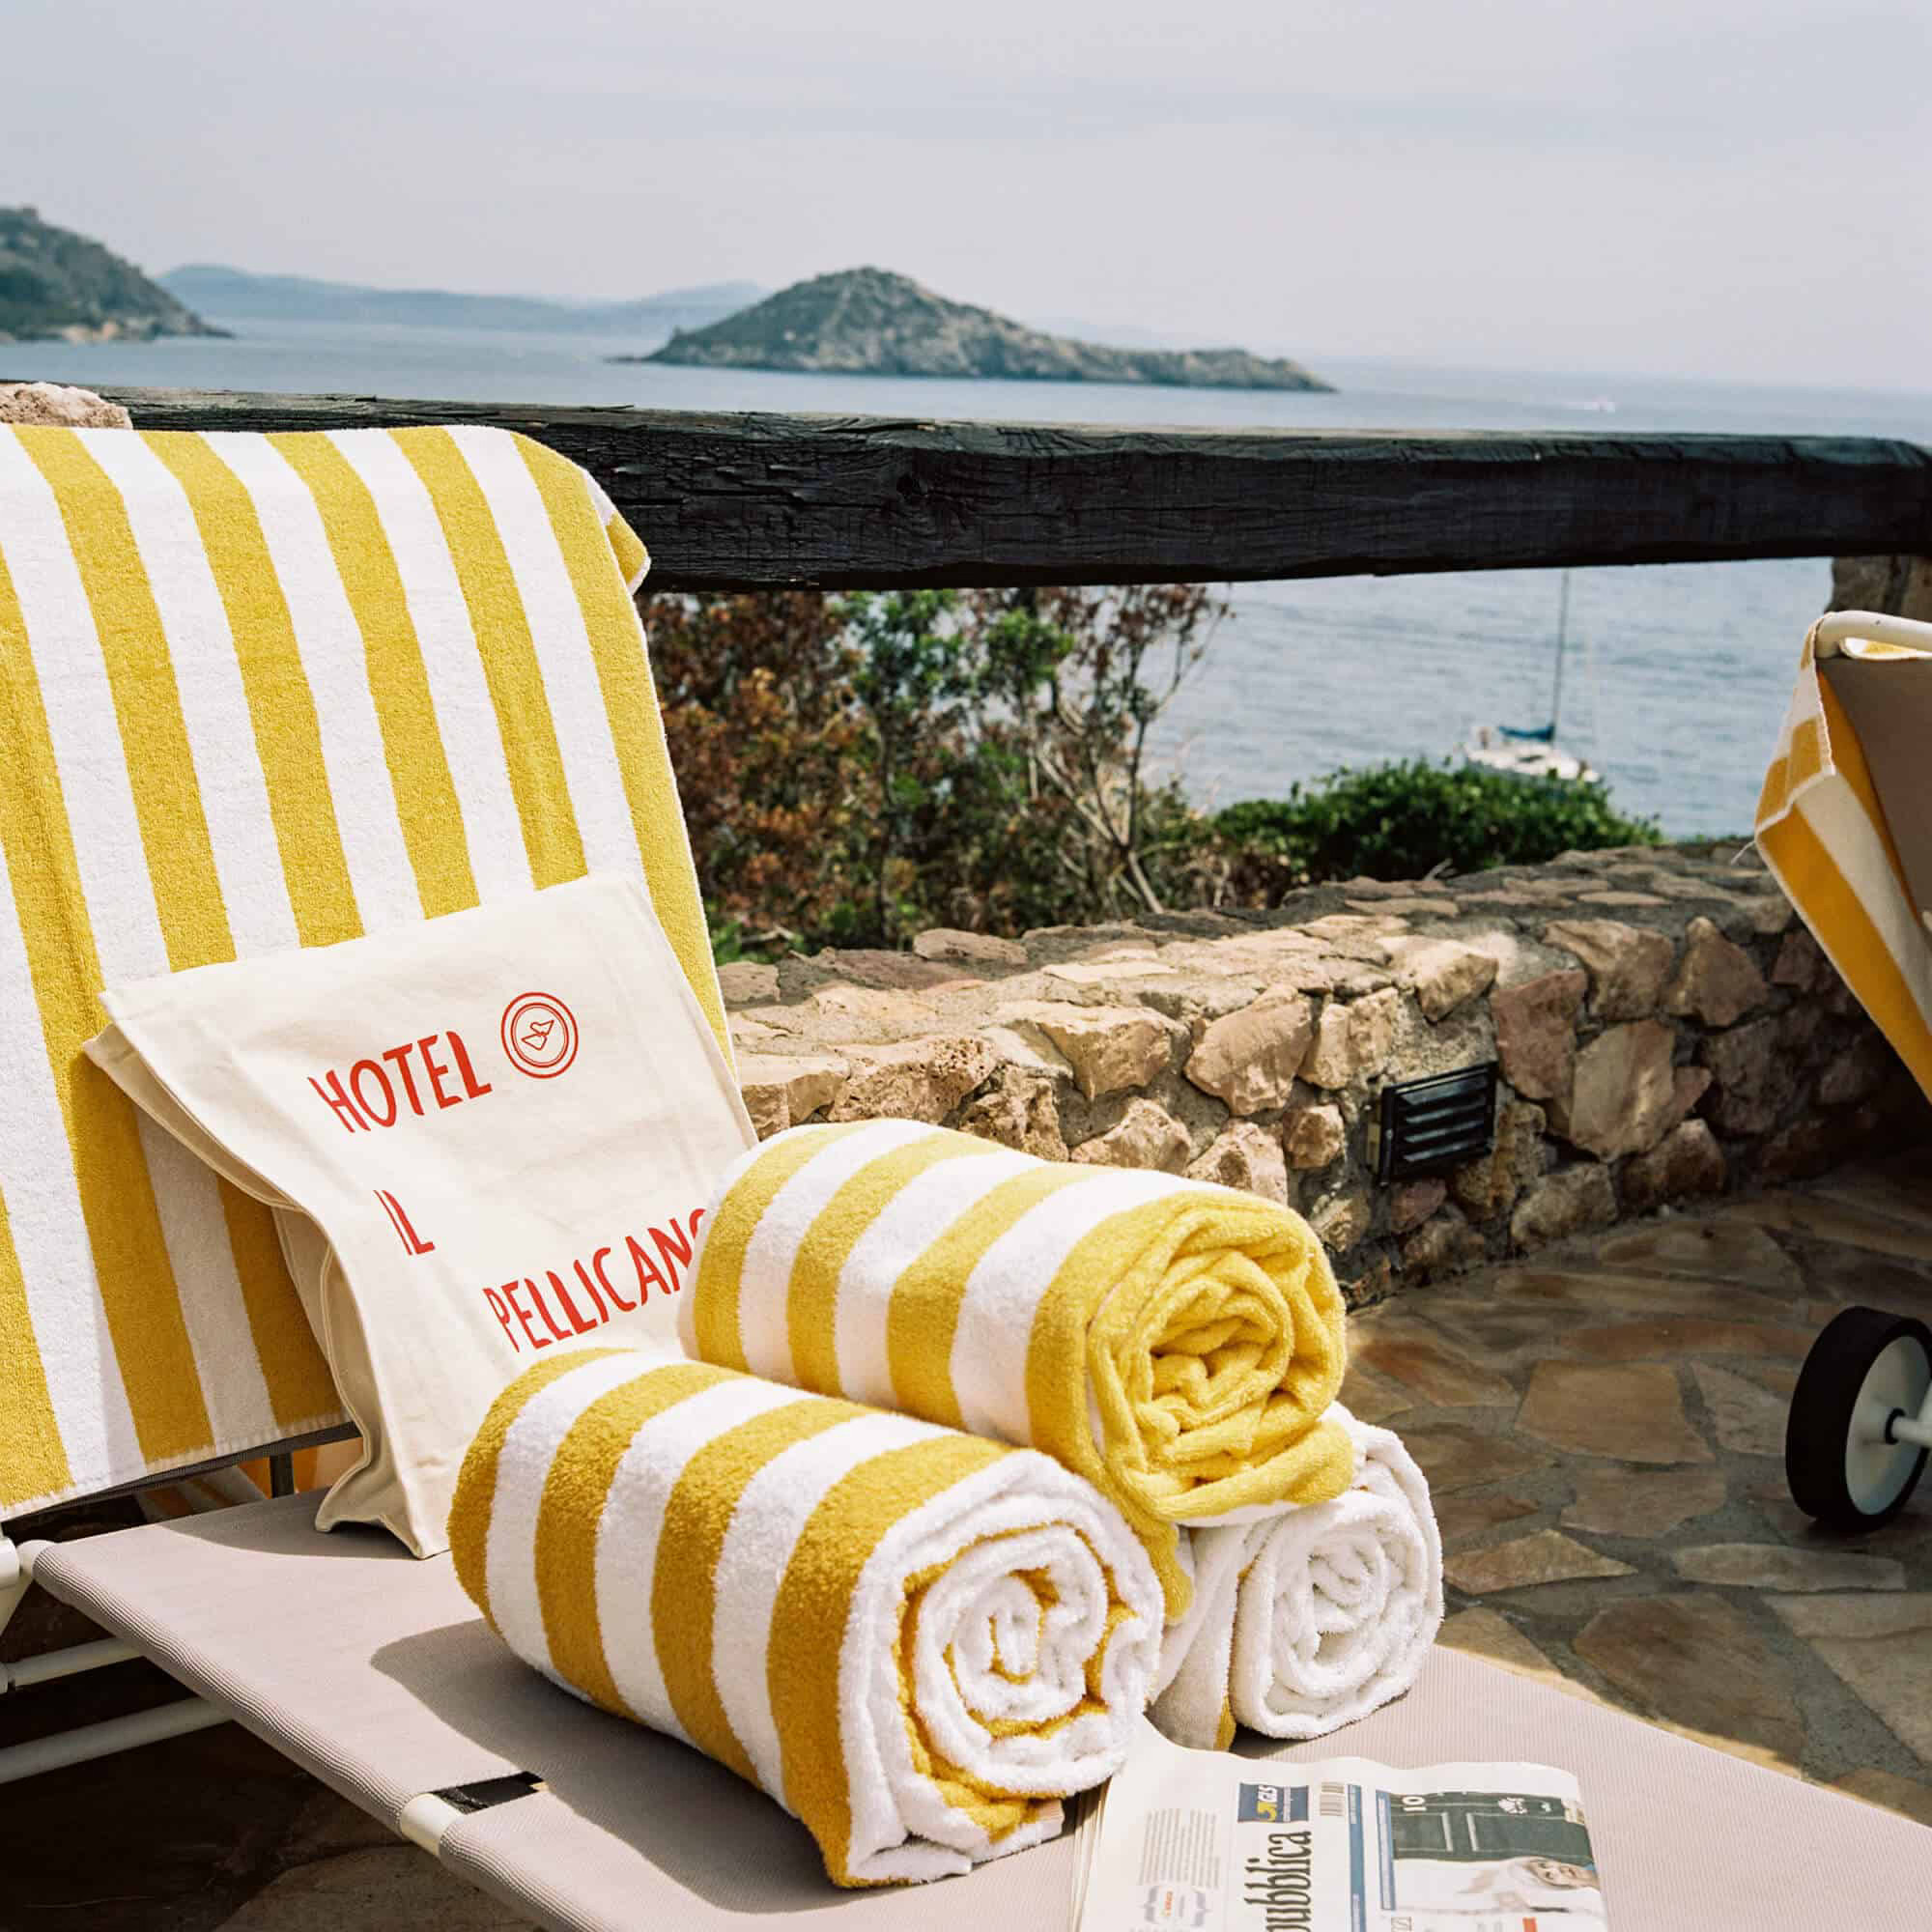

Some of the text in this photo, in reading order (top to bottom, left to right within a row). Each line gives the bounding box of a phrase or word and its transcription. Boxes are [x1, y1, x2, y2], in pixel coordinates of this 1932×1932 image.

[307, 1030, 492, 1133] HOTEL
[373, 1189, 436, 1256] IL
[1402, 1796, 1427, 1812] 10
